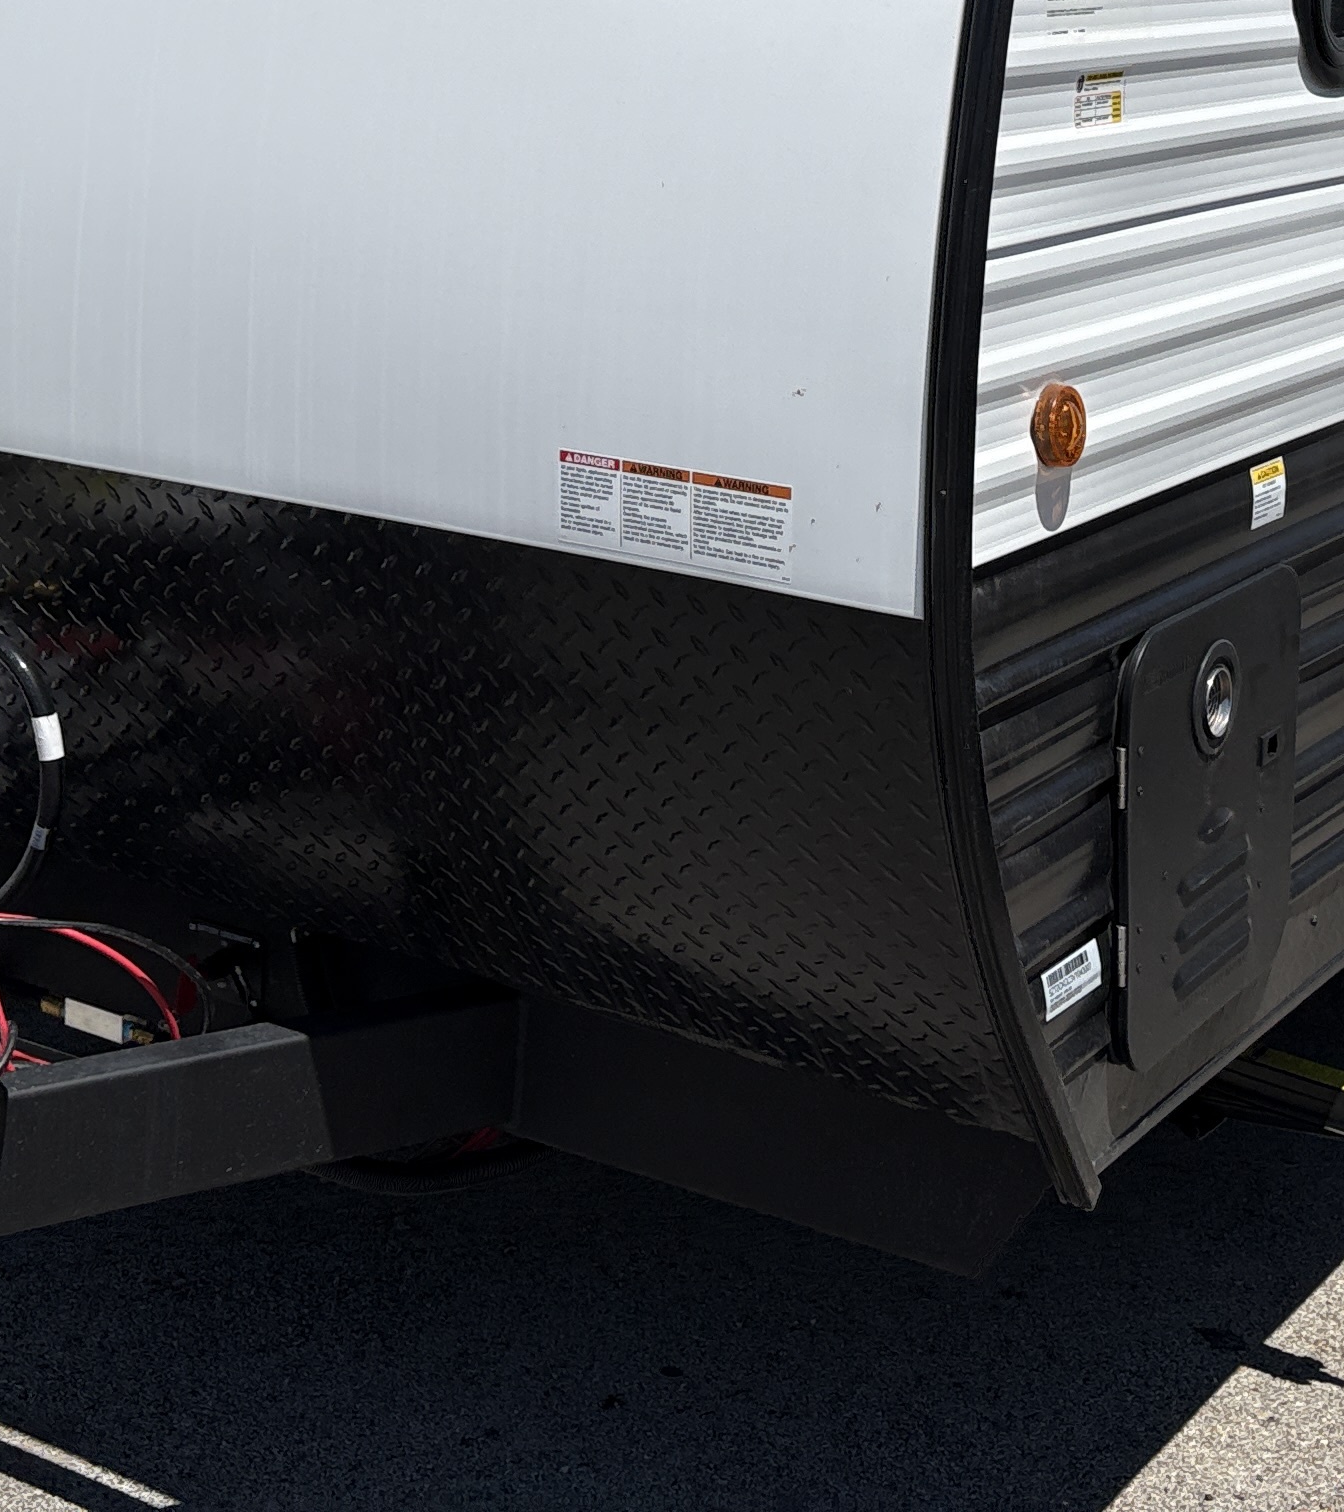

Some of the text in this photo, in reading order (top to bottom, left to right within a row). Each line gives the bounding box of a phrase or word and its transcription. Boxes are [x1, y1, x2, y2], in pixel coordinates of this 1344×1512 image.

[573, 453, 616, 470] DANGER
[638, 464, 683, 481] WARNING
[721, 478, 770, 496] WARNING
